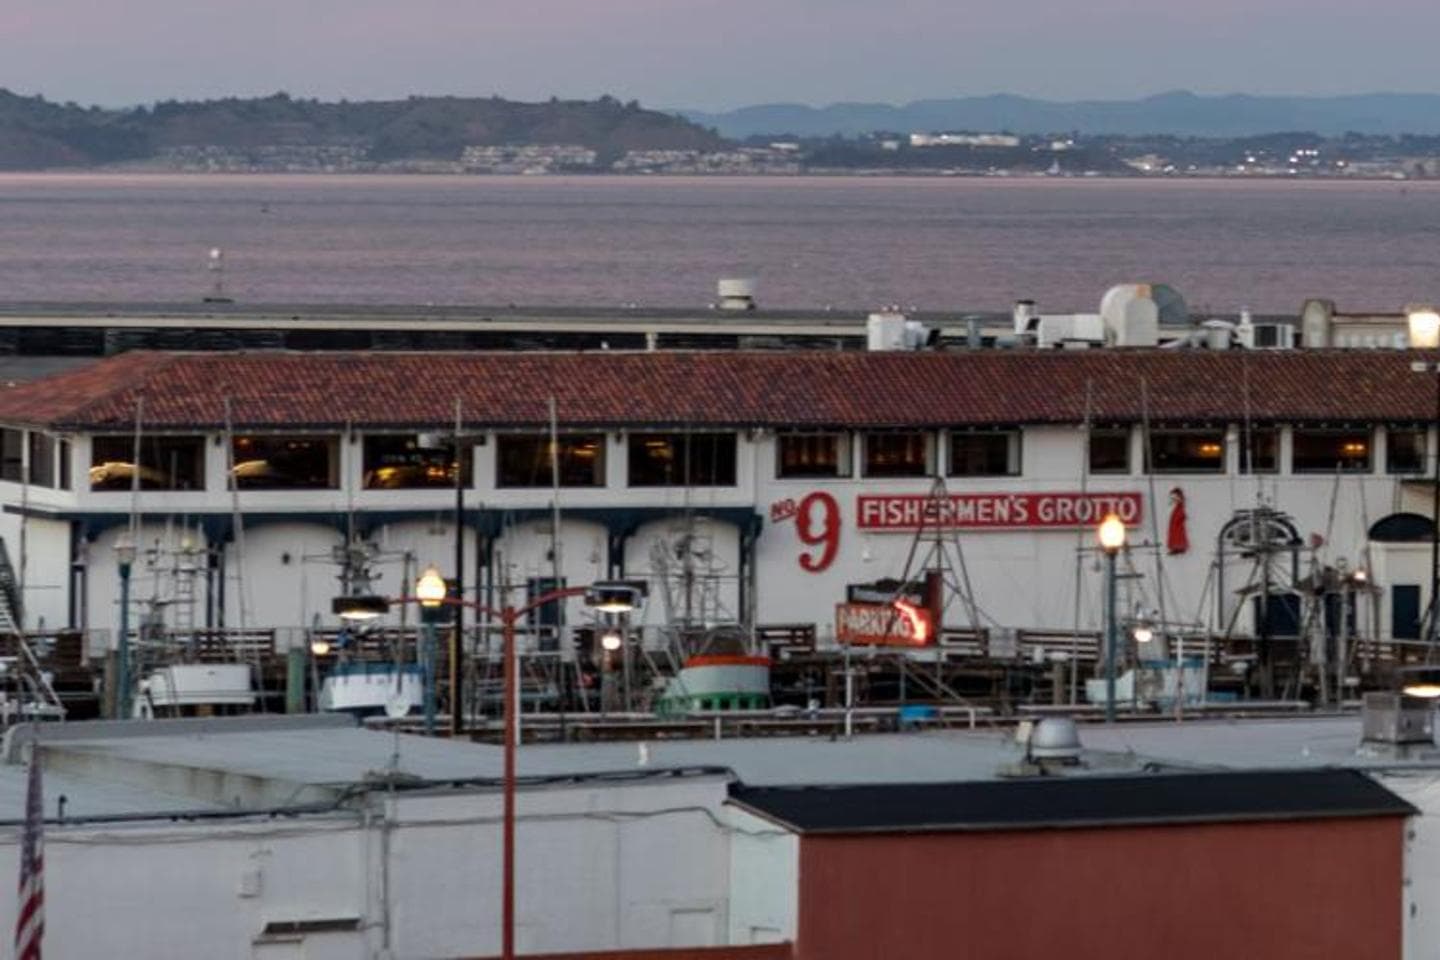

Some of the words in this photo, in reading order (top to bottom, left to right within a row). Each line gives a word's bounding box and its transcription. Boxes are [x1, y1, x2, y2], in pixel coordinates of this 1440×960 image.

[797, 491, 841, 573] 9
[862, 495, 1029, 523] FISHERMEN'S
[1037, 496, 1137, 521] GROTTO
